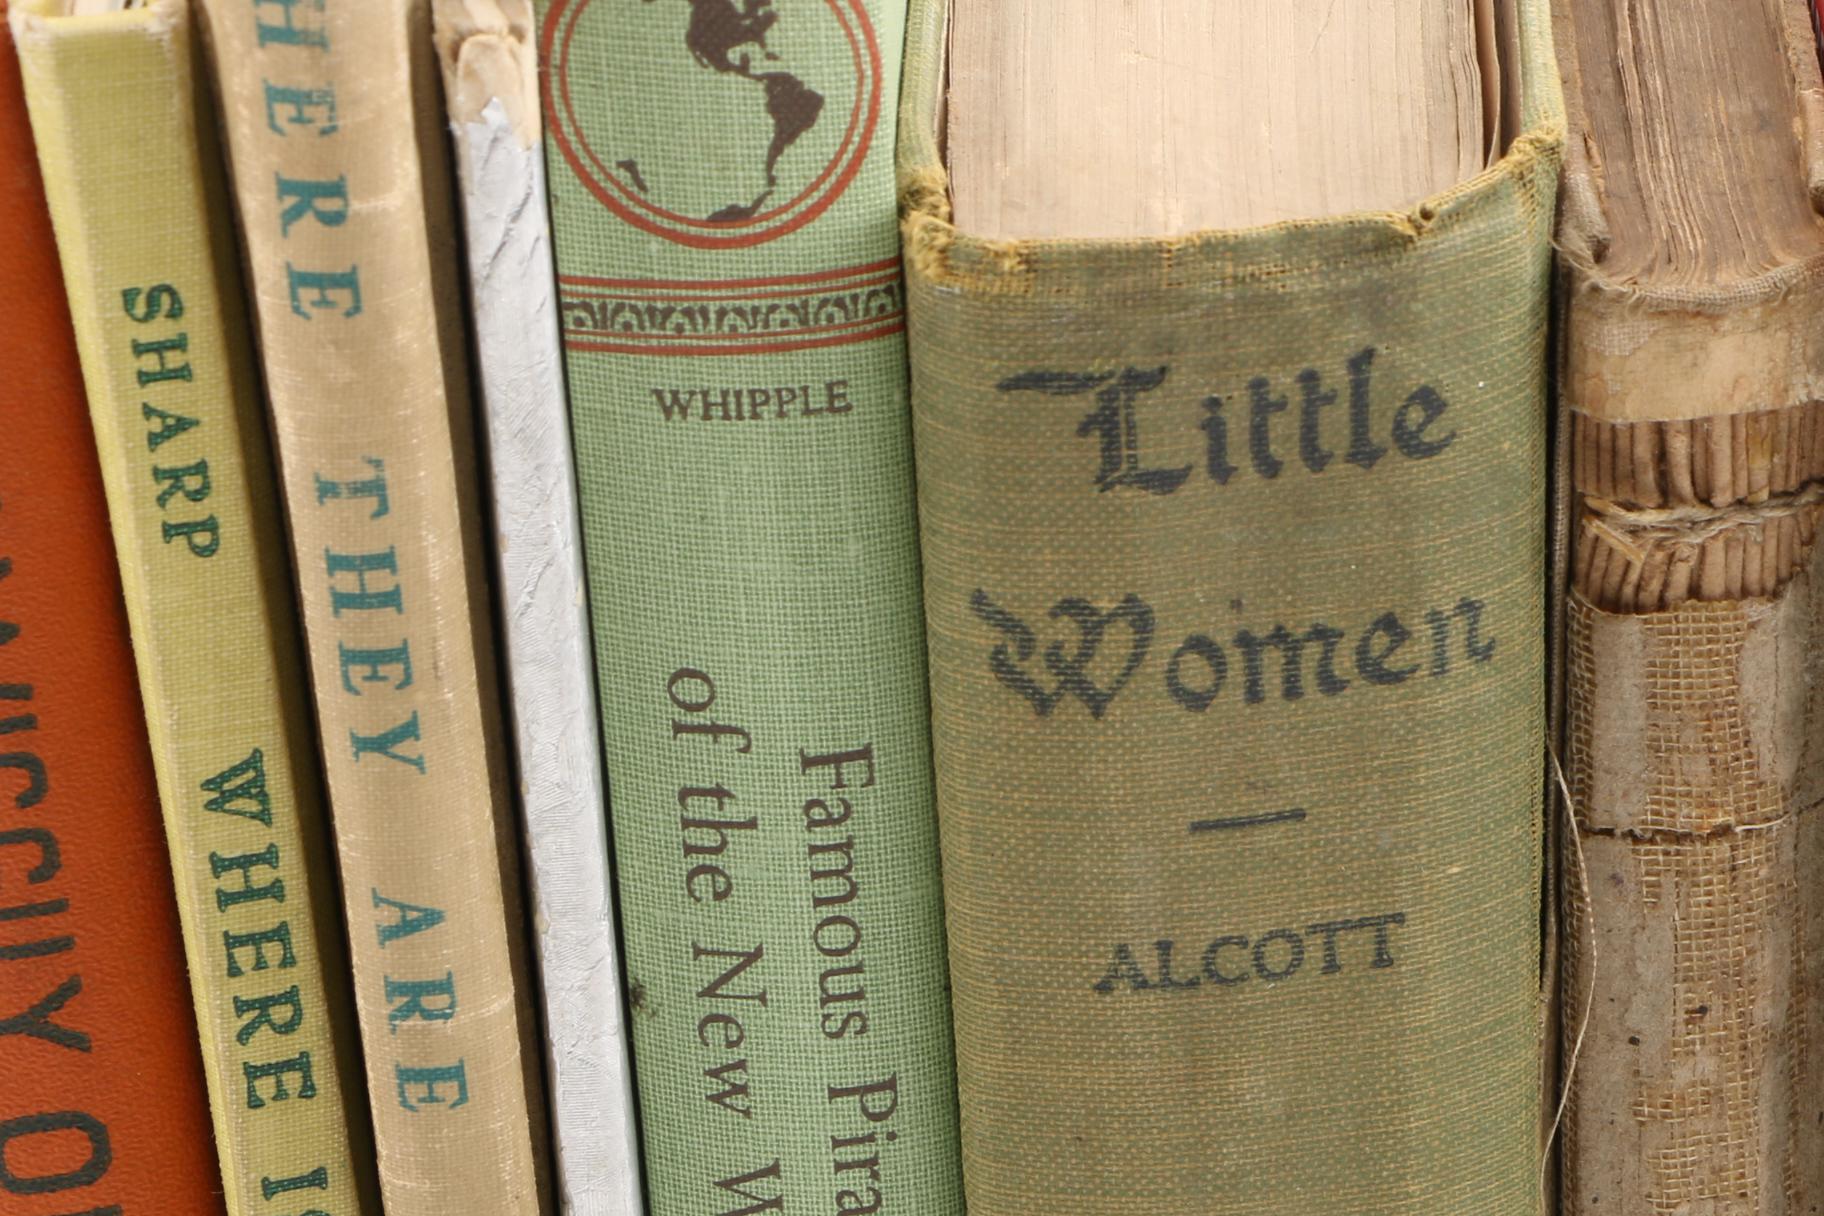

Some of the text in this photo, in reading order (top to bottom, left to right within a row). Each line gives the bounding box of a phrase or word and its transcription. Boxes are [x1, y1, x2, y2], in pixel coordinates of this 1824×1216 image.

[122, 283, 220, 558] SHARP
[651, 380, 853, 422] WHIPPLE
[997, 346, 1457, 494] Little
[253, 0, 469, 1113] HERE THEY ARE
[666, 667, 752, 755] of
[971, 588, 1495, 720] Women
[677, 781, 758, 903] the
[799, 741, 877, 1040] Famous
[200, 746, 318, 1110] WHERE
[1092, 912, 1404, 993] ALCOTT
[692, 942, 767, 1119] New
